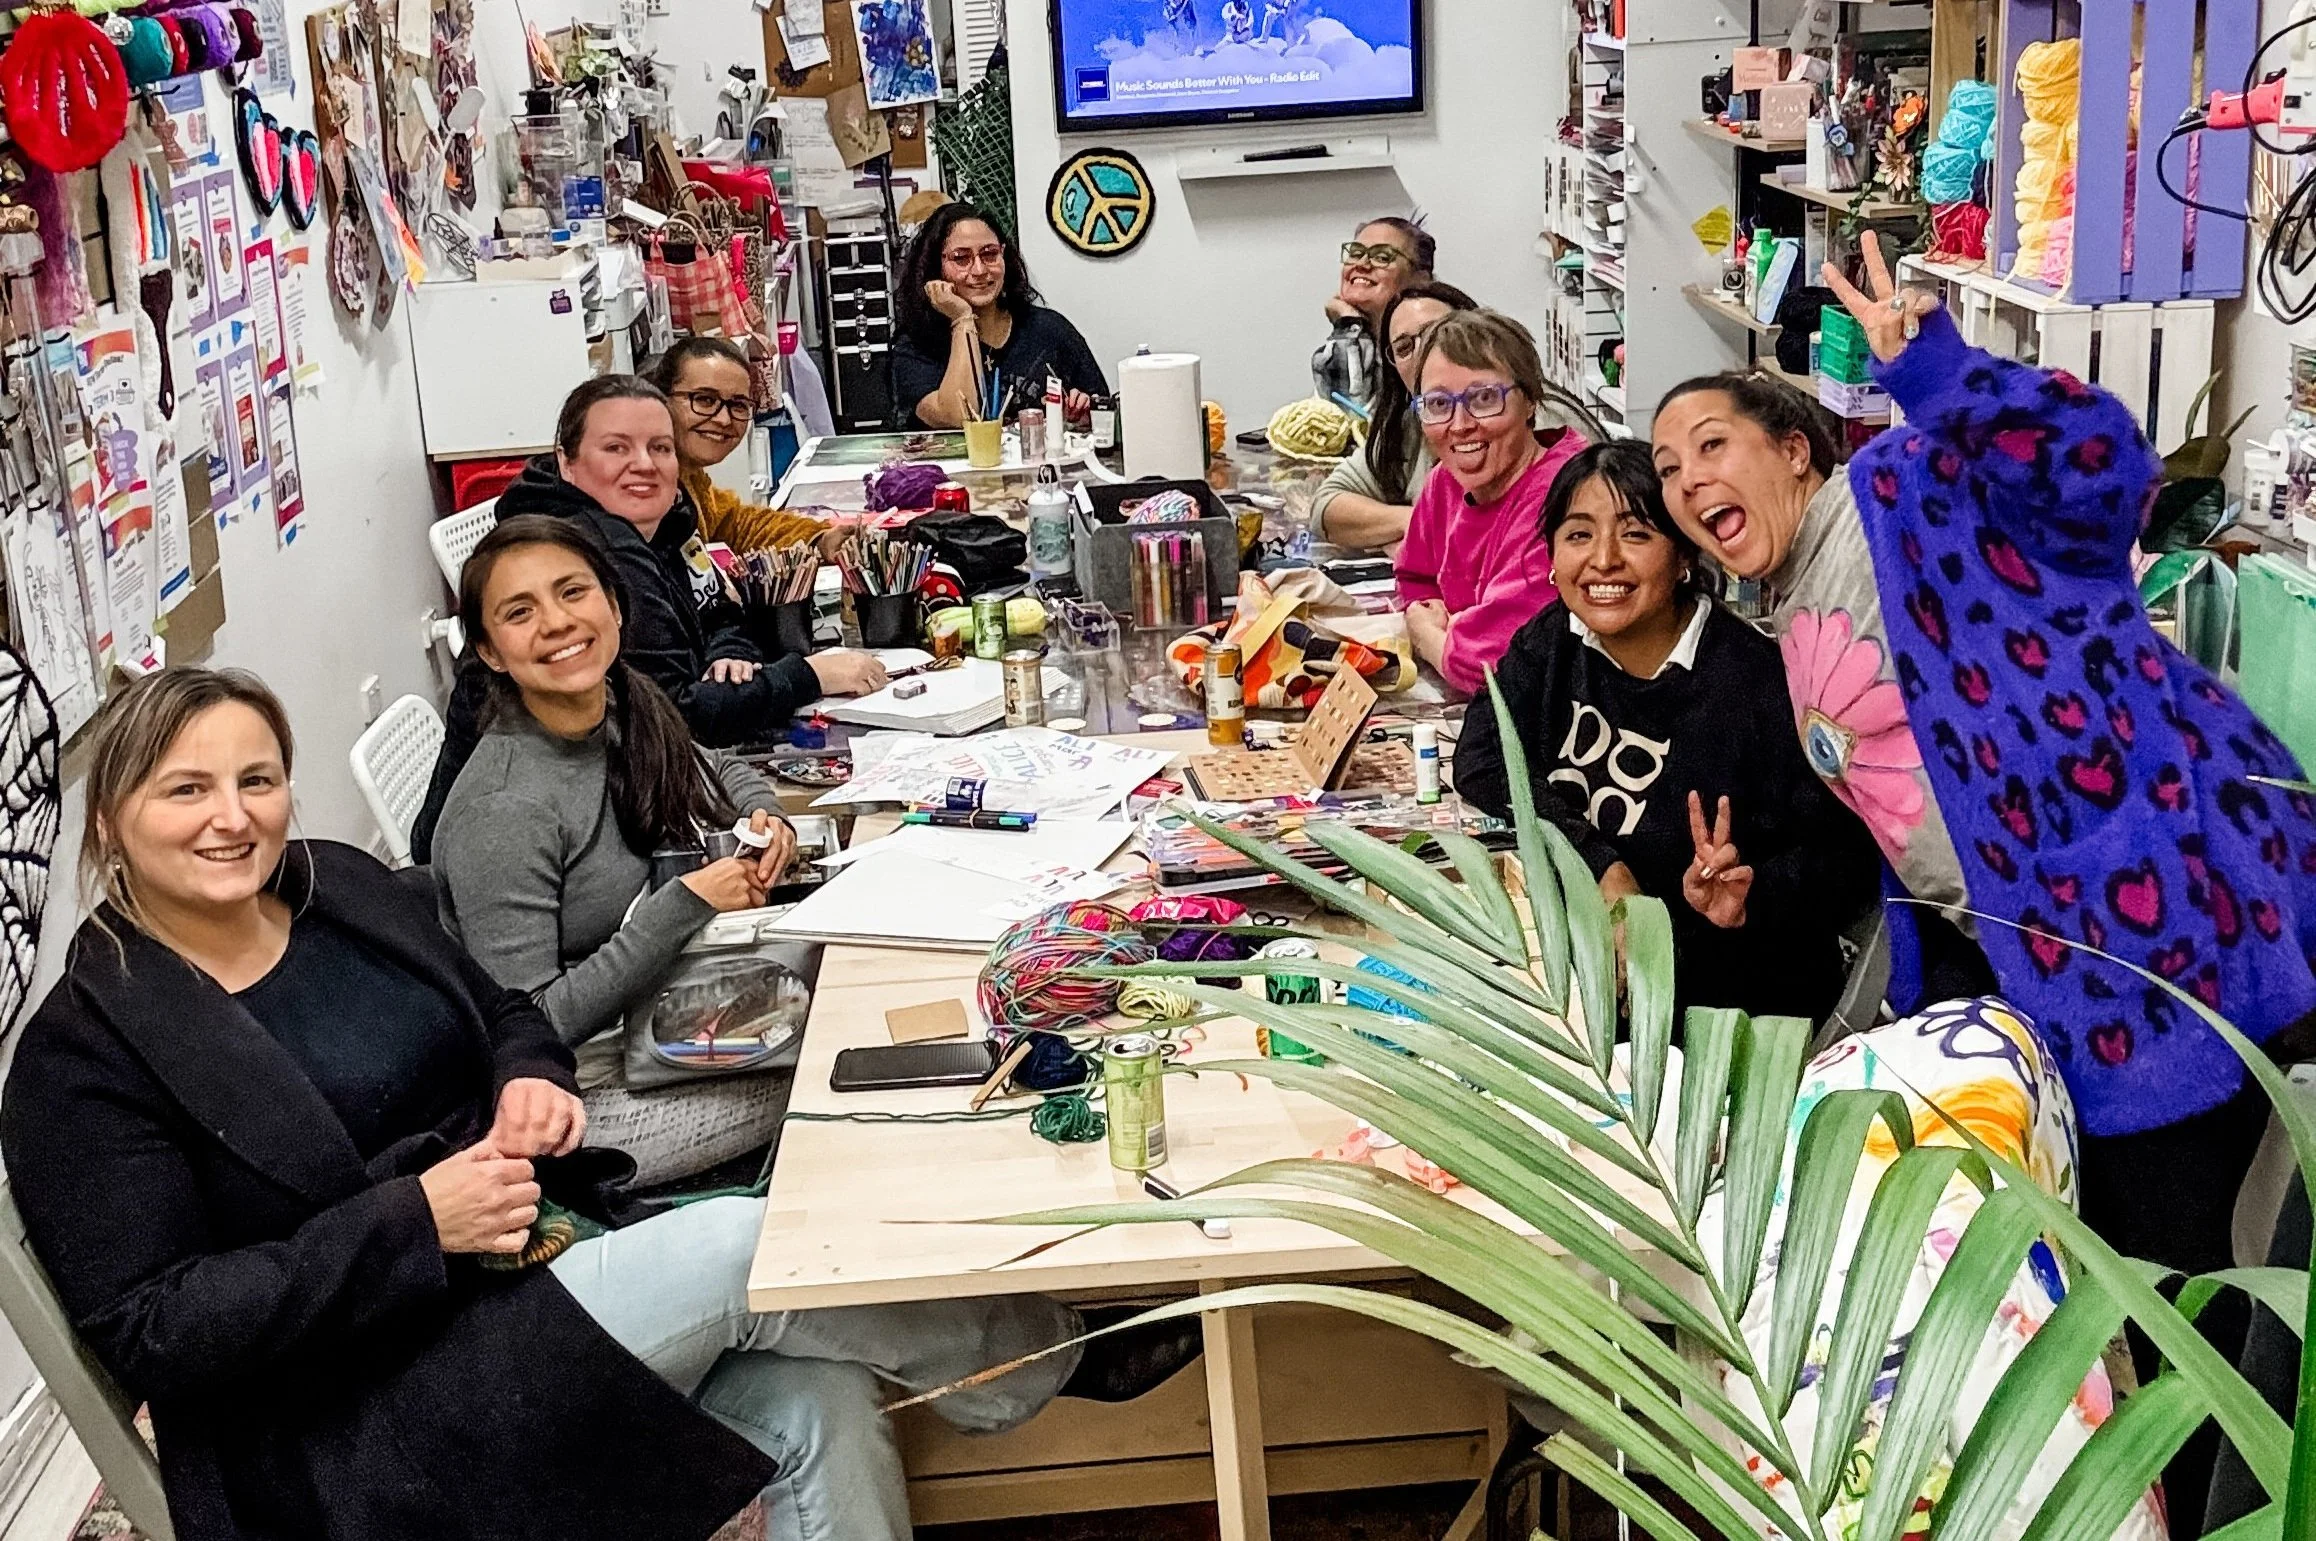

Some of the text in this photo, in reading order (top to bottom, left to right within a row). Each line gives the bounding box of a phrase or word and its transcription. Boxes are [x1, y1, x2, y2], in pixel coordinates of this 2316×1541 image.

[1115, 80, 1145, 92] Music
[1145, 79, 1184, 91] Sounds
[1217, 75, 1243, 86] With
[1243, 73, 1264, 85] You
[1269, 71, 1299, 84] Radio
[1299, 69, 1320, 81] Edit
